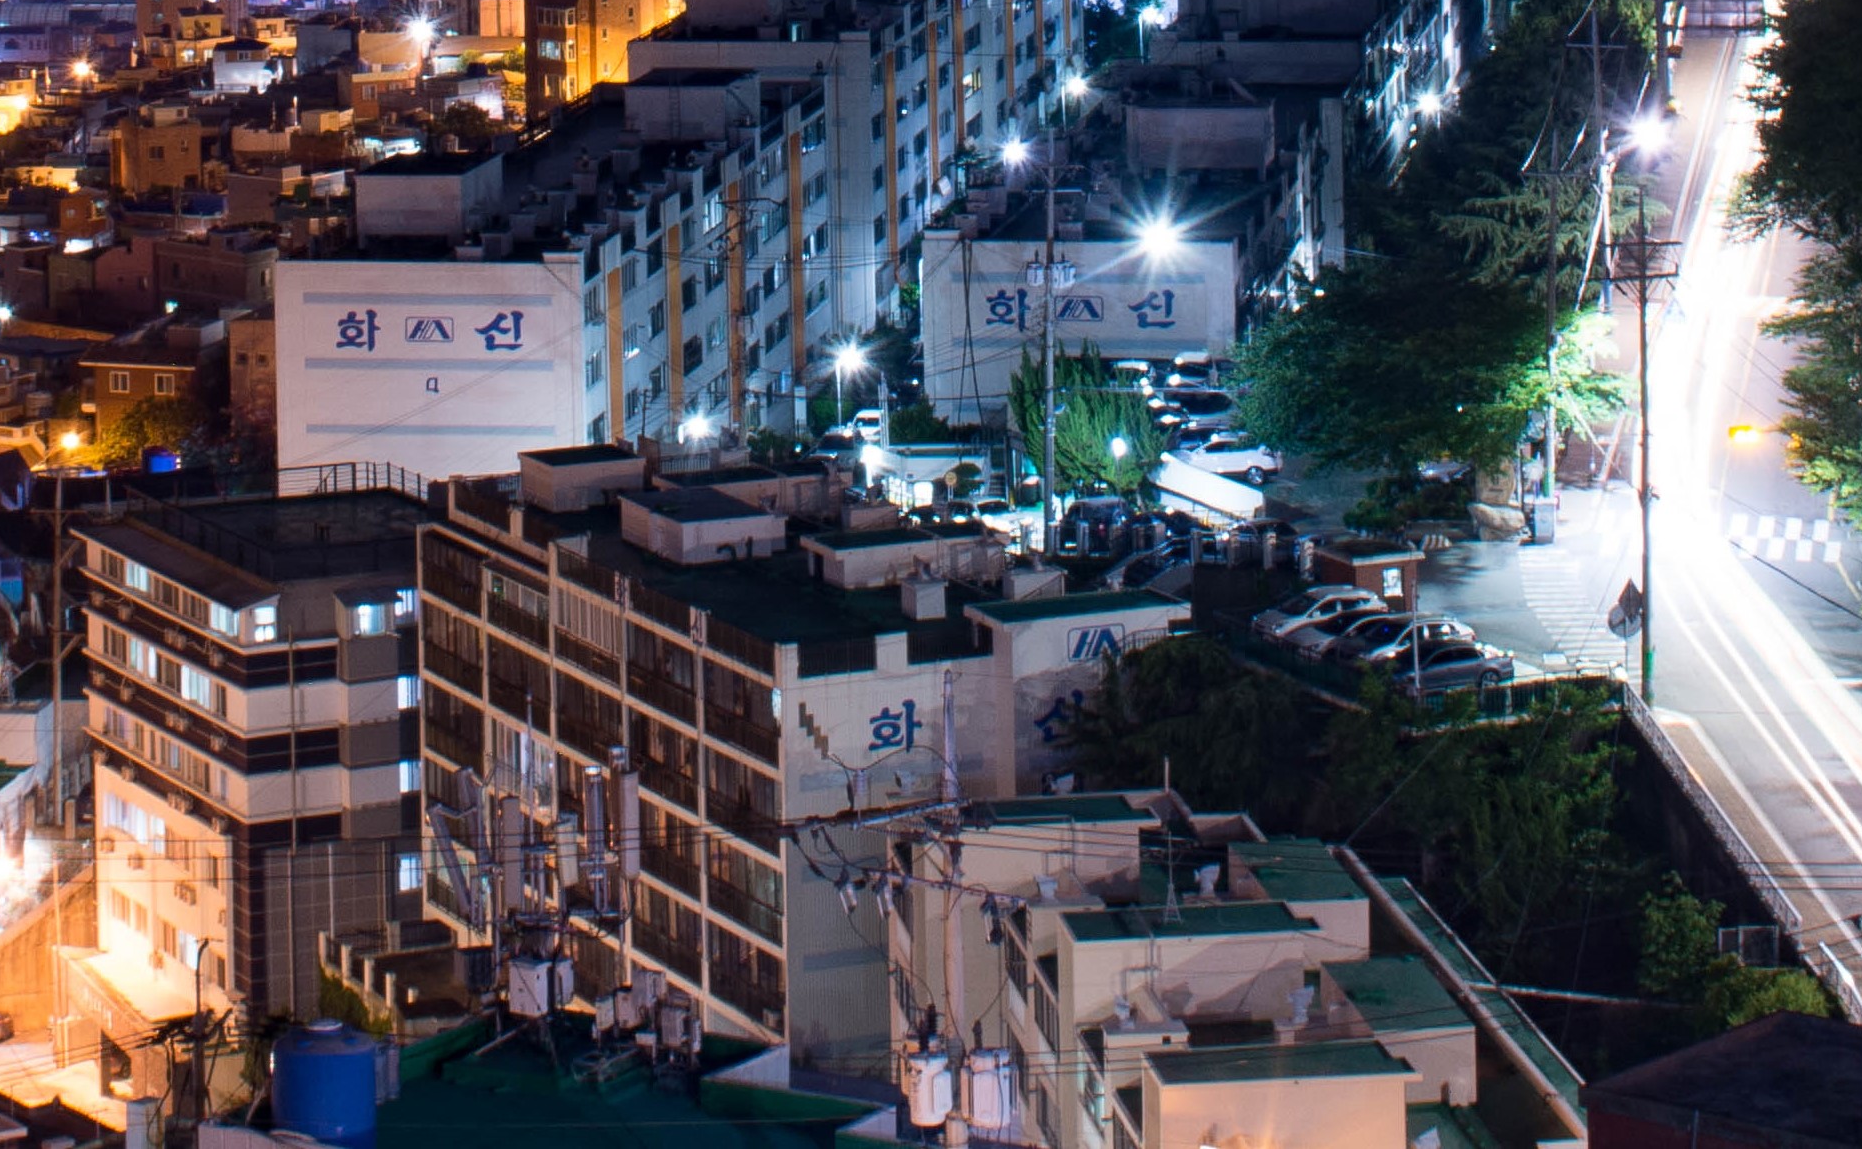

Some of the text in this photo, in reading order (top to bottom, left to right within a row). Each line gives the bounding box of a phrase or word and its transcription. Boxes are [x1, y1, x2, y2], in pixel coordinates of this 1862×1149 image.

[336, 309, 381, 352] 화
[474, 310, 524, 351] 신
[985, 288, 1031, 332] 화
[1128, 289, 1175, 329] 신
[868, 699, 923, 753] 화
